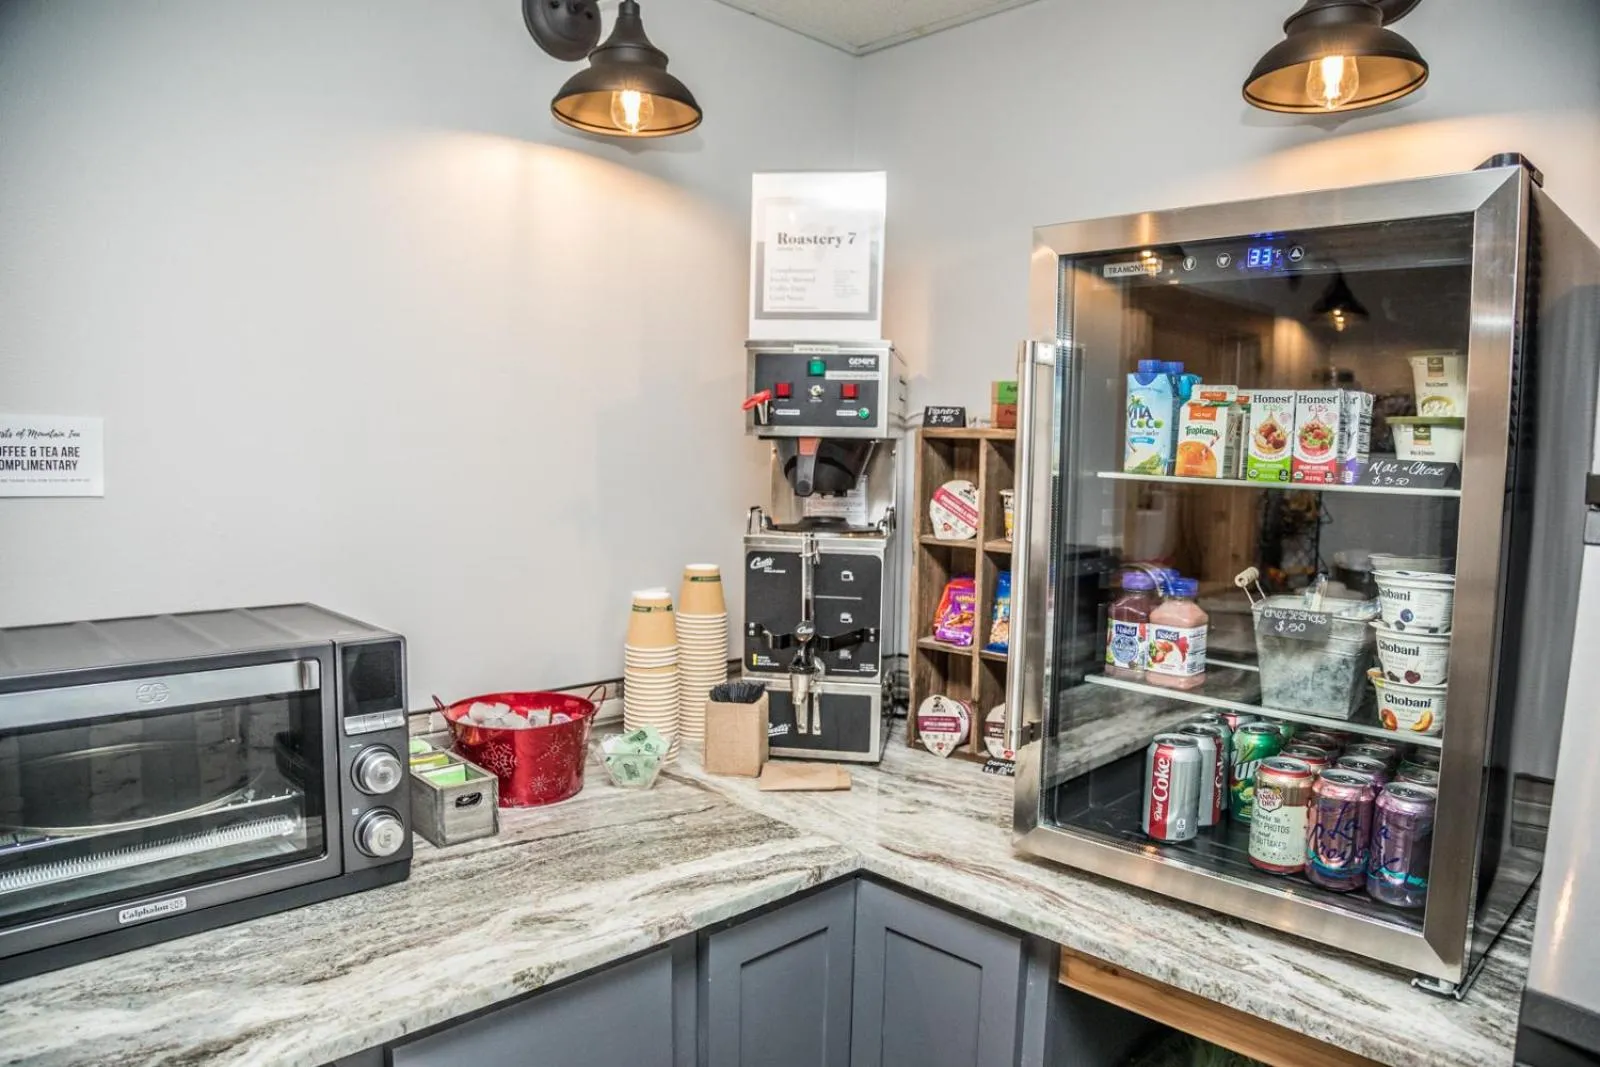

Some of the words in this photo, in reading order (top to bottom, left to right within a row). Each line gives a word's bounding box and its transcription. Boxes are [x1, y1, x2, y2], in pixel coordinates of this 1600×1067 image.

[777, 231, 843, 248] Roastery
[847, 232, 857, 245] 7
[1249, 248, 1271, 266] 33
[1253, 394, 1293, 404] Honest
[1298, 394, 1338, 404] Honest
[27, 429, 65, 440] Mountain
[1185, 425, 1218, 436] Tropicana
[30, 446, 37, 457] &
[39, 446, 58, 457] TEA
[61, 446, 80, 458] ARE
[0, 459, 78, 471] OMPLIMENTARY
[1379, 640, 1420, 657] Chobani
[1385, 693, 1432, 708] Chobani
[1152, 757, 1171, 802] Coke
